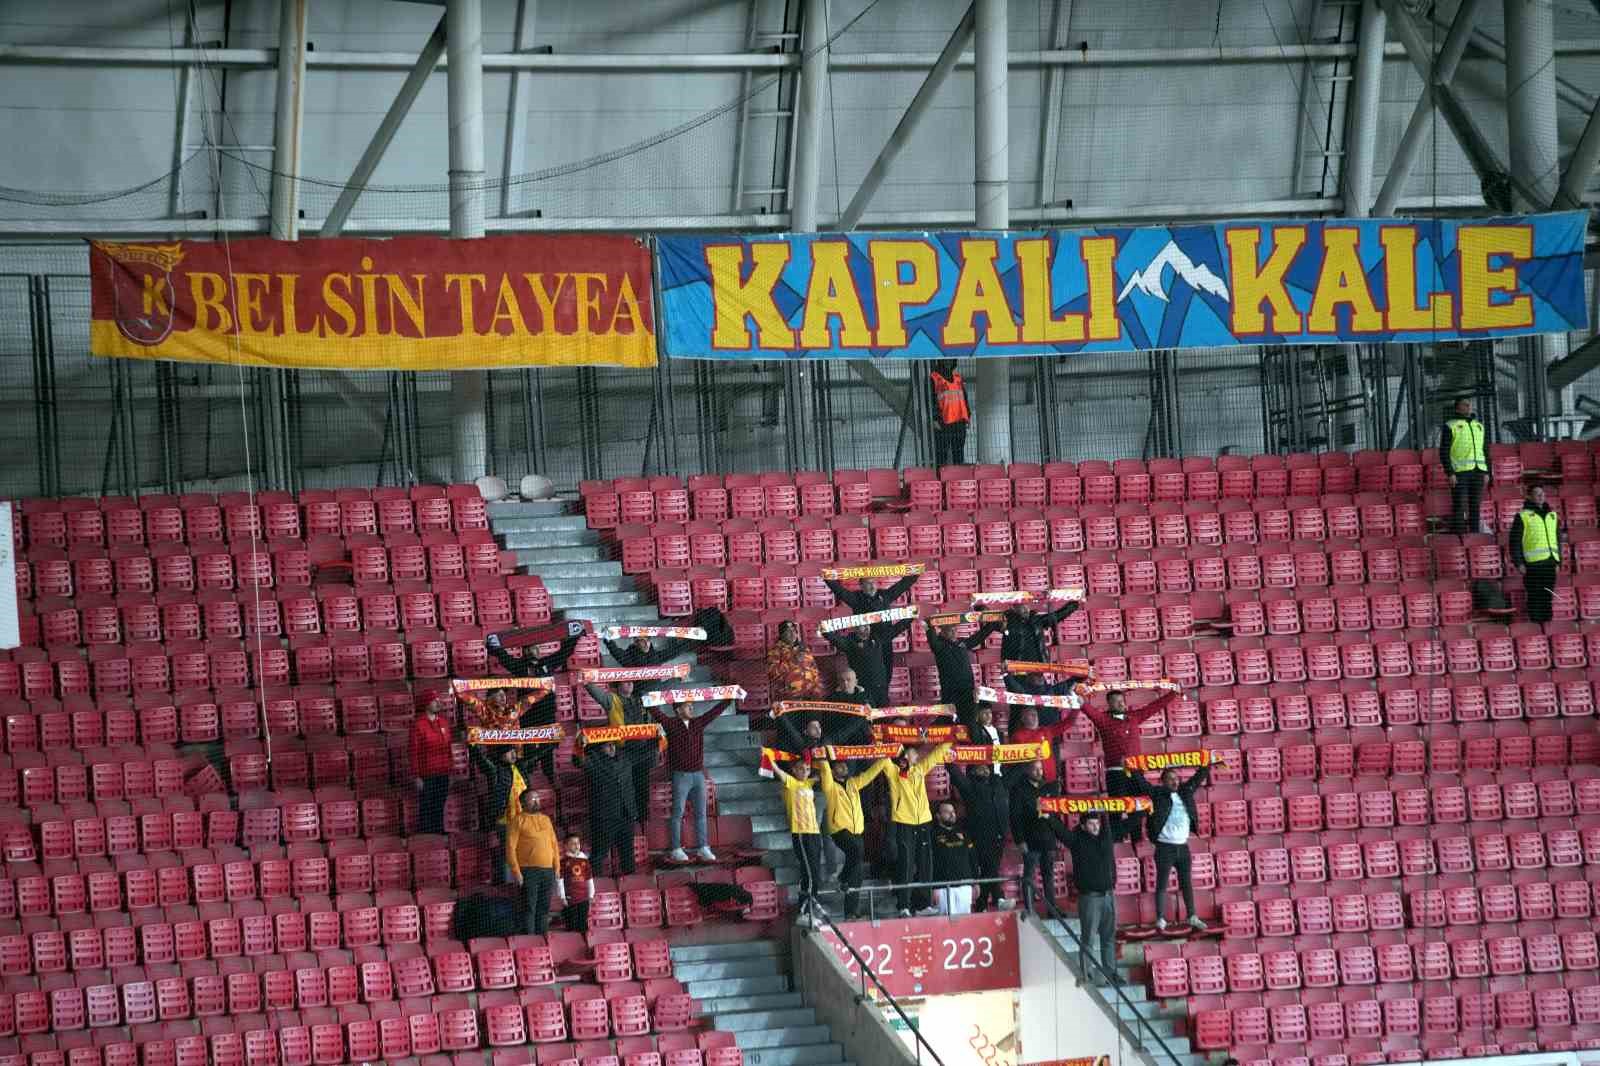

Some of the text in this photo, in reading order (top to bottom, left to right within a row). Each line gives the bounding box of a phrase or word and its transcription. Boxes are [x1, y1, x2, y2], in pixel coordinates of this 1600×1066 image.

[186, 255, 650, 338] BELSİN TAYFA
[704, 225, 1533, 350] KAPALI KALE
[957, 749, 1029, 761] KAPALI KALE
[1147, 753, 1201, 769] SOLDIER
[1069, 799, 1125, 813] SOLDIER
[943, 936, 994, 969] 223
